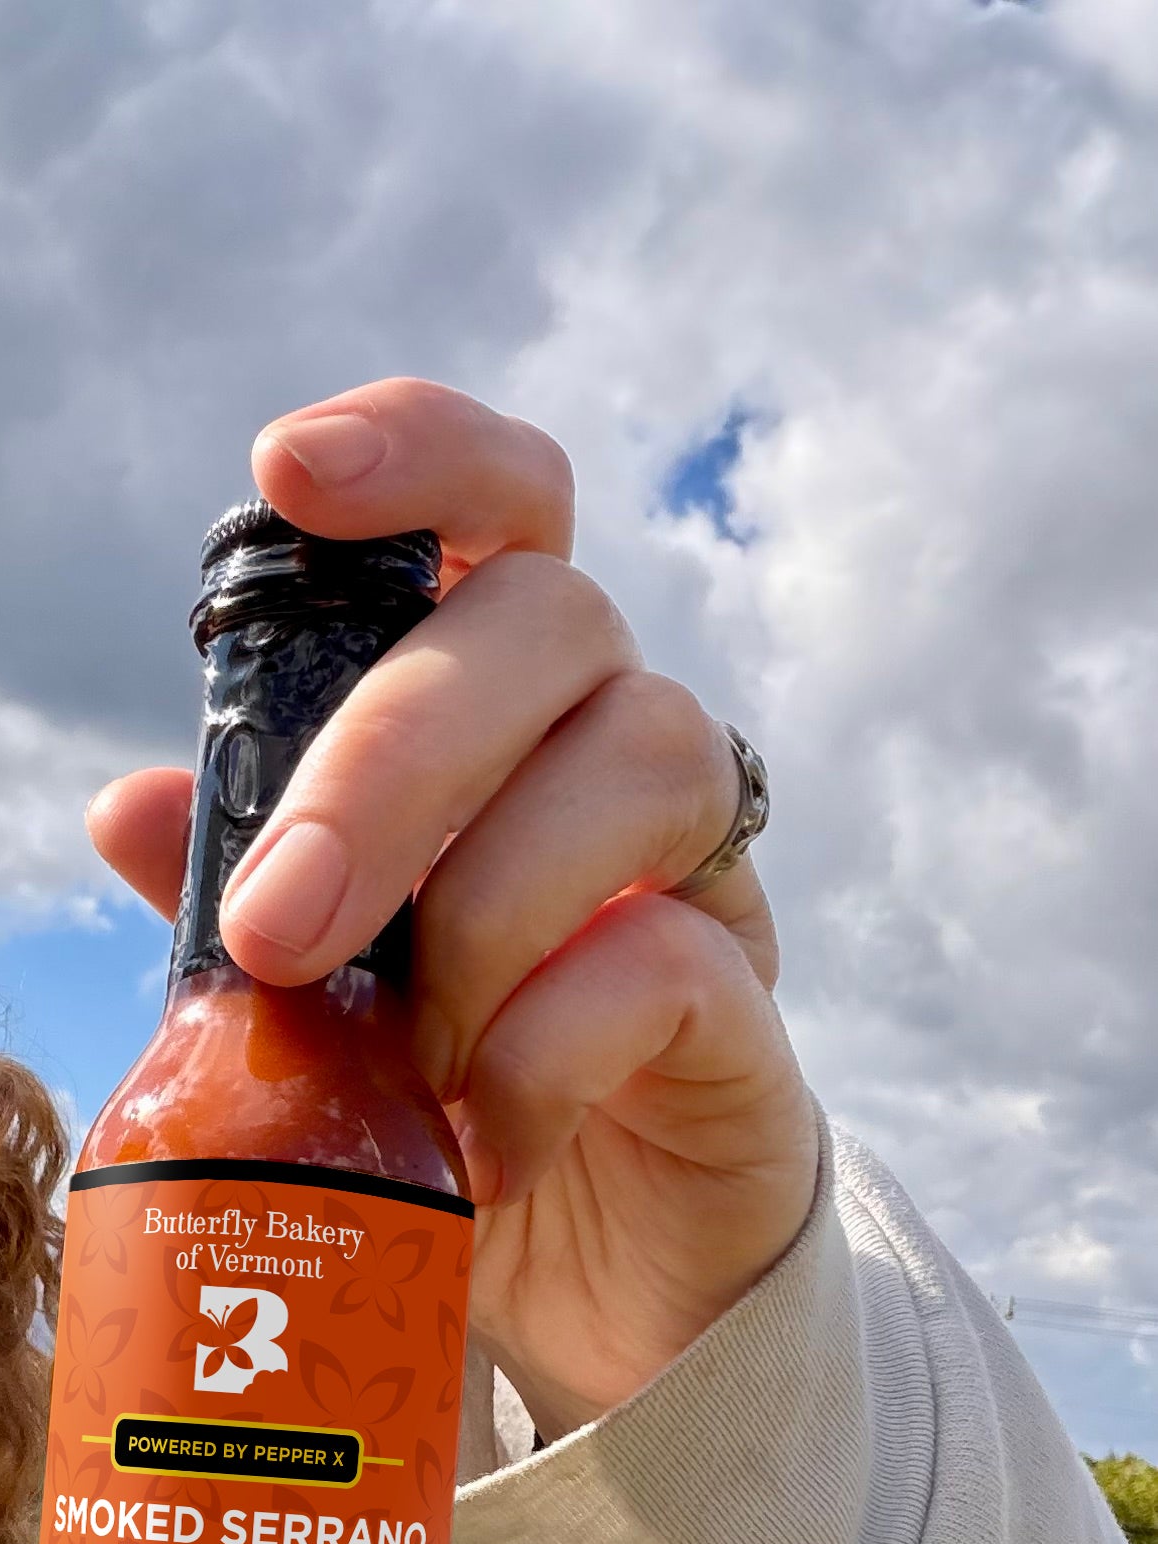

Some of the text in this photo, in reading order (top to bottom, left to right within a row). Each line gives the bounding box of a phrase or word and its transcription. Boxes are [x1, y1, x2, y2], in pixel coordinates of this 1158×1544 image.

[143, 1206, 365, 1260] Butterfly Bakery
[175, 1243, 324, 1280] of Vermont
[128, 1435, 345, 1468] POWERED BY PEPPER X
[53, 1494, 205, 1544] SMOKED
